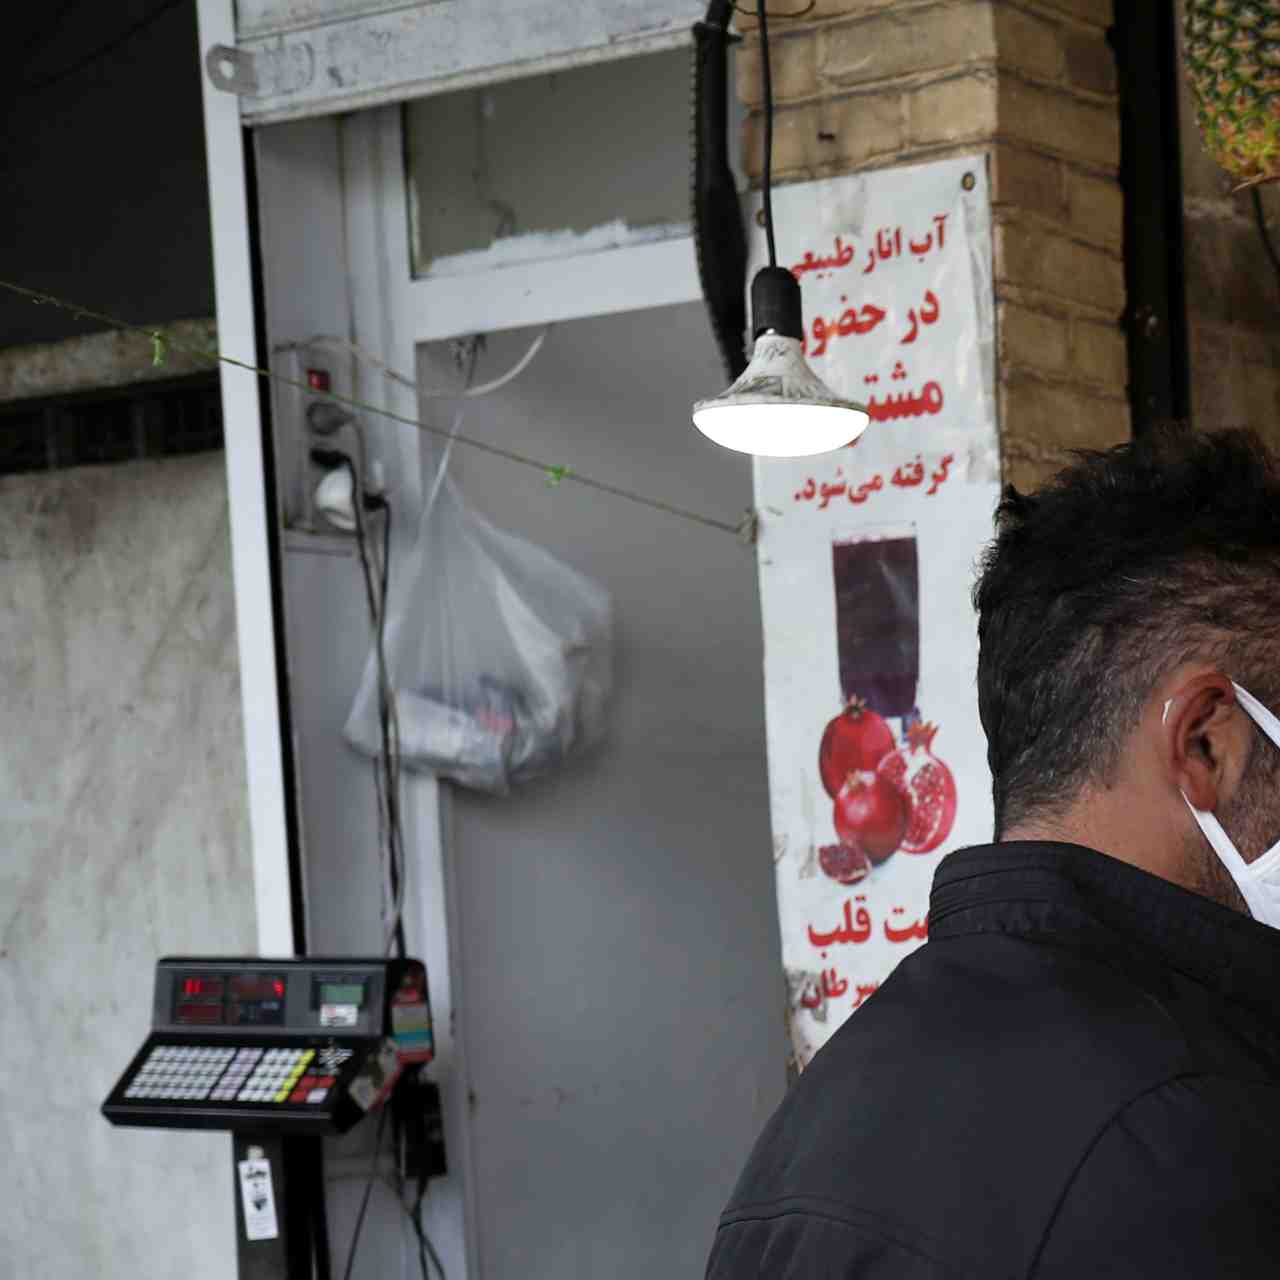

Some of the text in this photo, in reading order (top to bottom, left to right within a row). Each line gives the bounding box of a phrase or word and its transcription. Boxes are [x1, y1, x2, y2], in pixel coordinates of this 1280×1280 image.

[862, 226, 902, 275] انار
[908, 213, 949, 262] آب
[900, 289, 940, 345] در
[807, 896, 872, 958] قلب
